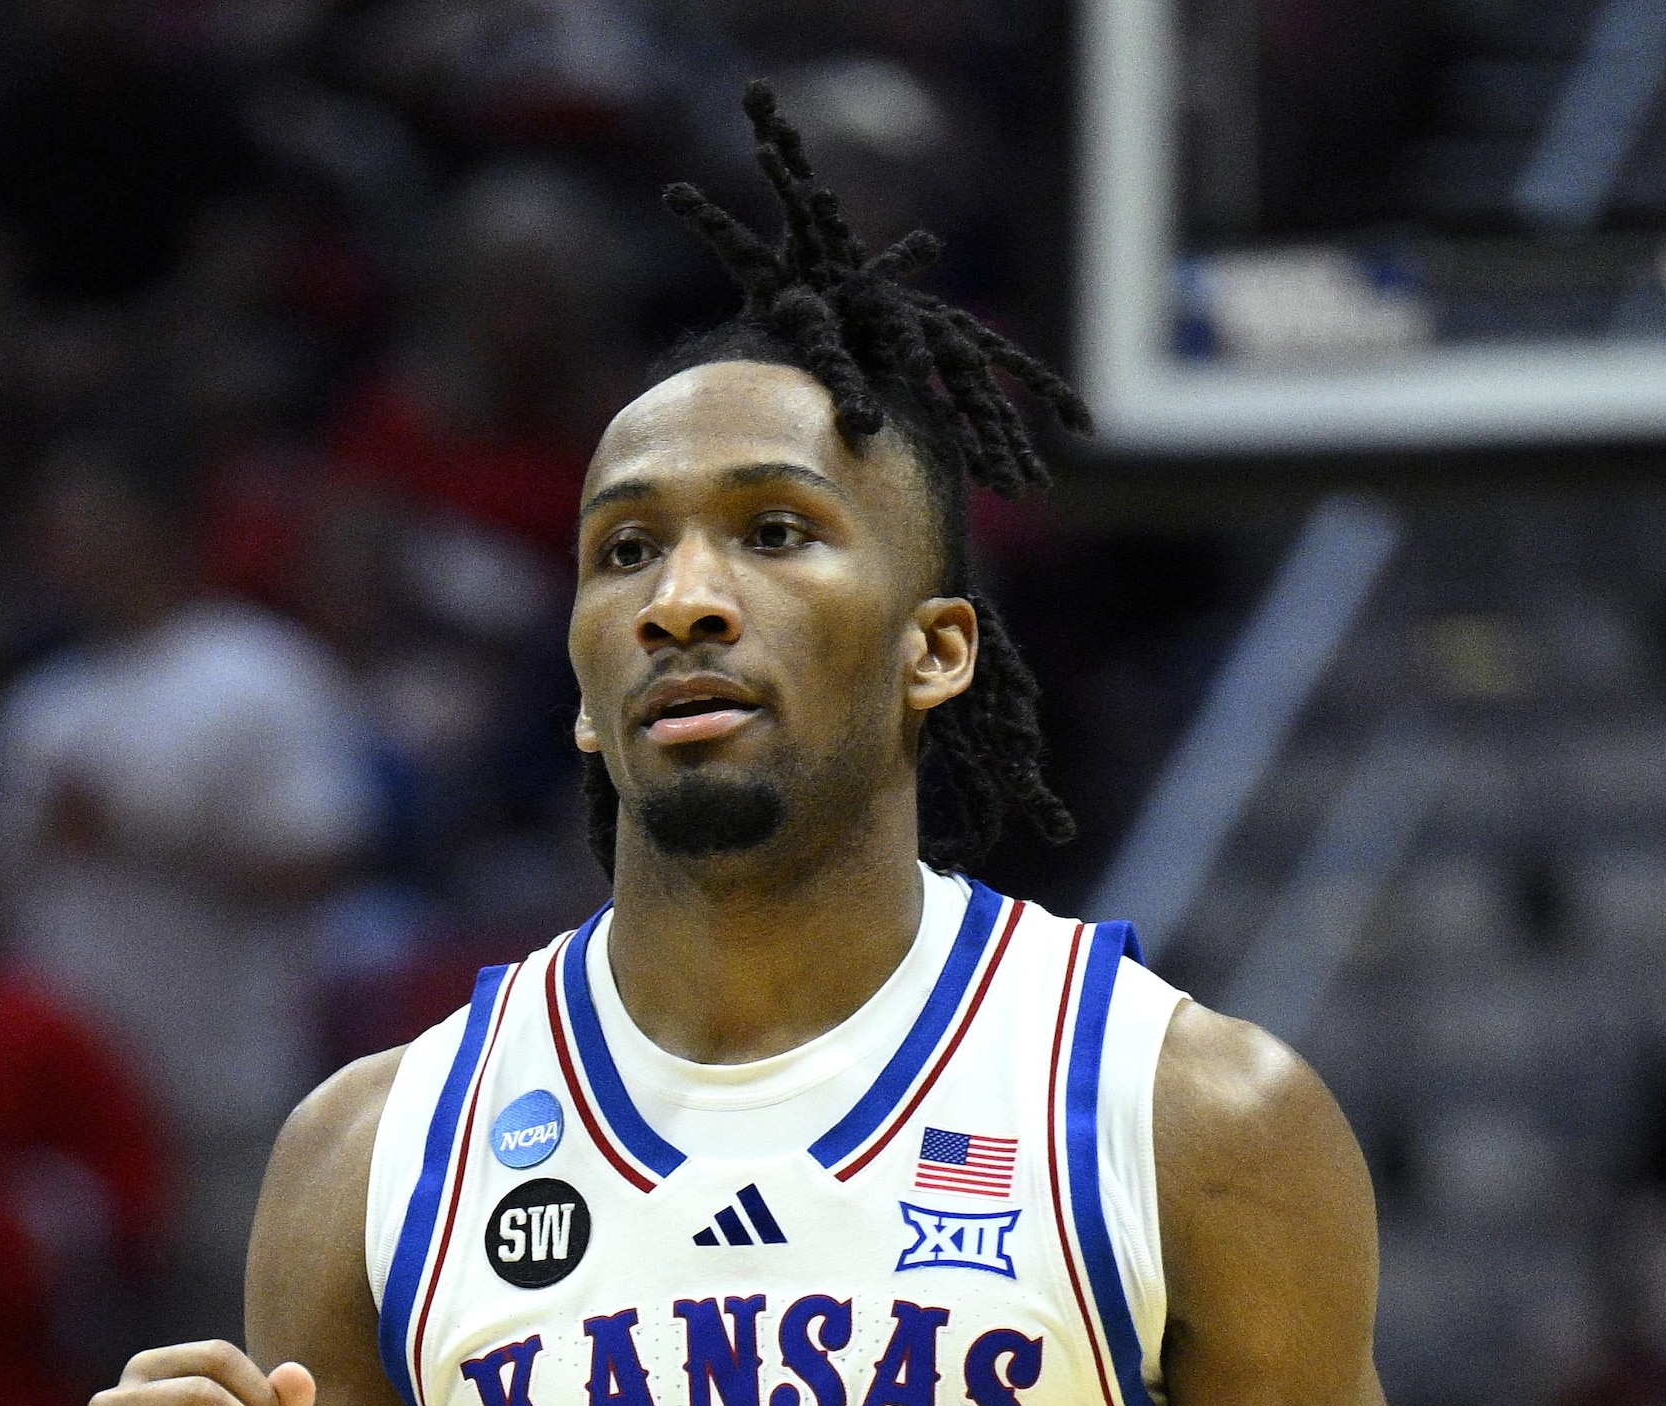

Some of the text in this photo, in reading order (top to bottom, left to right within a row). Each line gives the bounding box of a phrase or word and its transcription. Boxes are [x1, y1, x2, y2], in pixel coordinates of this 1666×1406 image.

[499, 1120, 559, 1152] NCAA
[497, 1202, 576, 1263] SW
[895, 1200, 1023, 1280] XII
